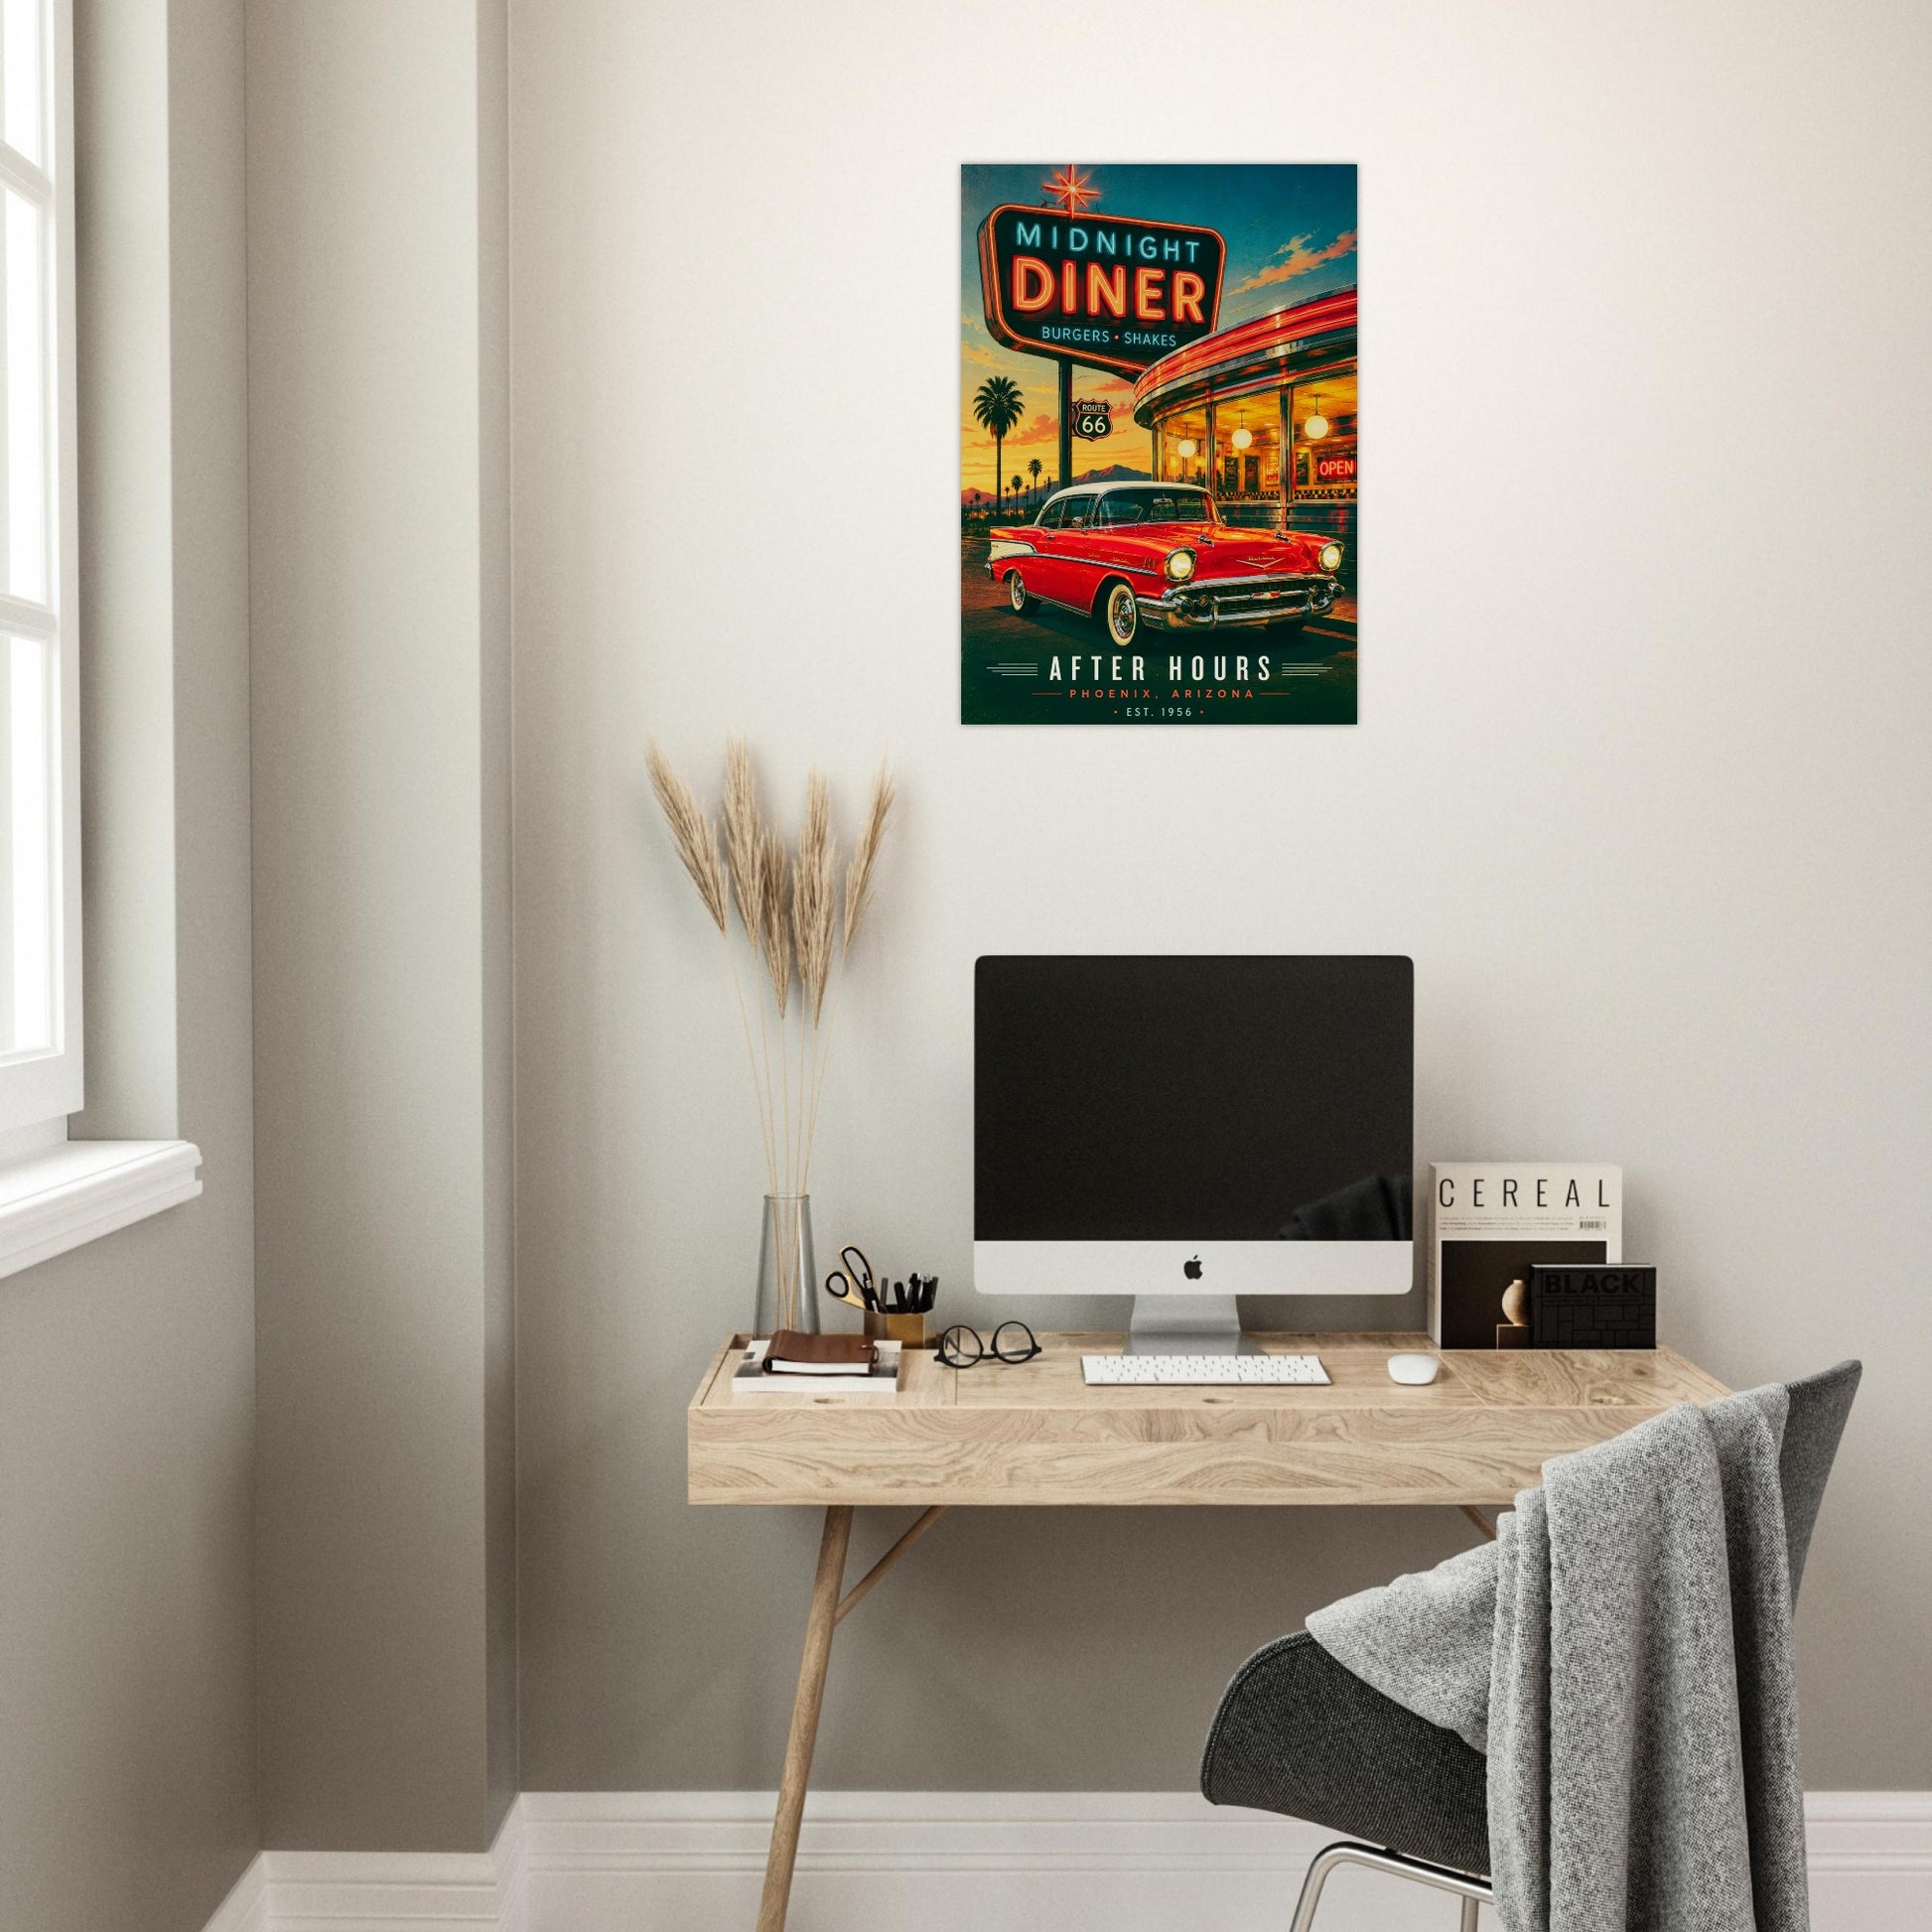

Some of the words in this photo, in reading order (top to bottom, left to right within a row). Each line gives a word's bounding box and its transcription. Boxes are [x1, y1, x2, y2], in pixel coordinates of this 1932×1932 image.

[1015, 220, 1200, 264] MIDNIGHT
[1012, 254, 1206, 326] DINER
[1041, 326, 1111, 344] BURGERS
[1124, 331, 1177, 347] SHAKES
[1081, 403, 1106, 414] ROUTE
[1081, 415, 1106, 434] 66
[1319, 460, 1353, 476] OPEN
[1048, 655, 1146, 682] AFTER
[1169, 655, 1272, 682] HOURS
[1069, 689, 1160, 700] PHOENIX,
[1172, 689, 1254, 699] ARIZONA
[1126, 707, 1154, 718] EST.
[1161, 707, 1192, 718] 1956
[1439, 1178, 1610, 1207] CEREAL
[1544, 1273, 1641, 1295] BLACK
